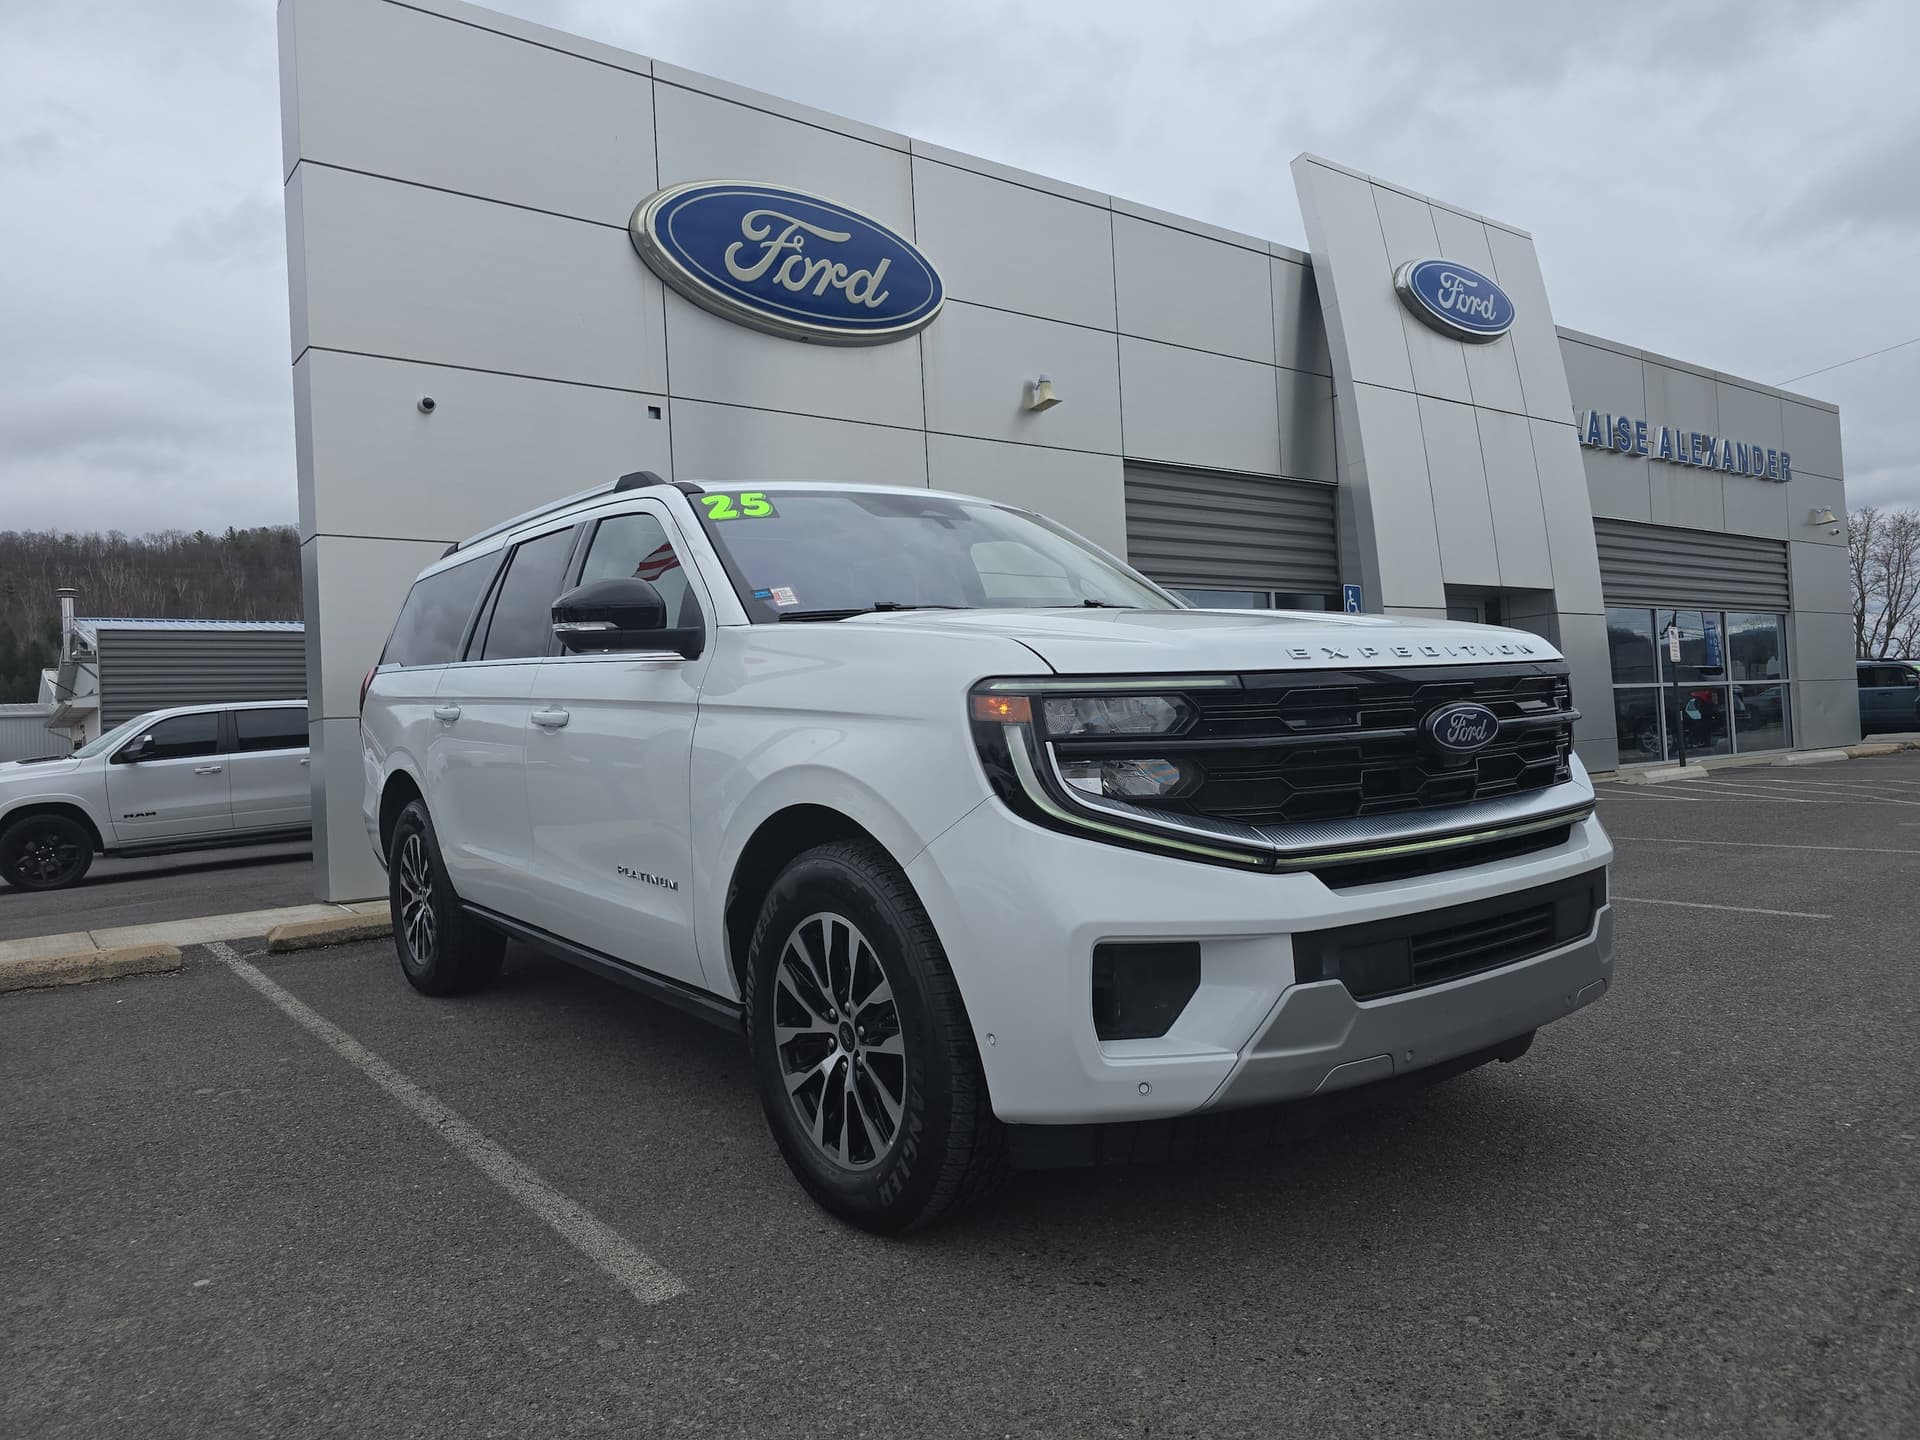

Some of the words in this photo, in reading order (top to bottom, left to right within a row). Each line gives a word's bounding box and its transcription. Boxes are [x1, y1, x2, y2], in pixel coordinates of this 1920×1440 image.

[725, 209, 892, 308] Ford
[1438, 271, 1497, 321] Ford
[1578, 410, 1649, 456] AISE
[1654, 425, 1793, 482] ALEXANDER
[701, 492, 774, 520] 25
[1285, 643, 1535, 660] EXPEDITION
[1446, 712, 1488, 743] Ford
[617, 865, 679, 892] PLATINUM
